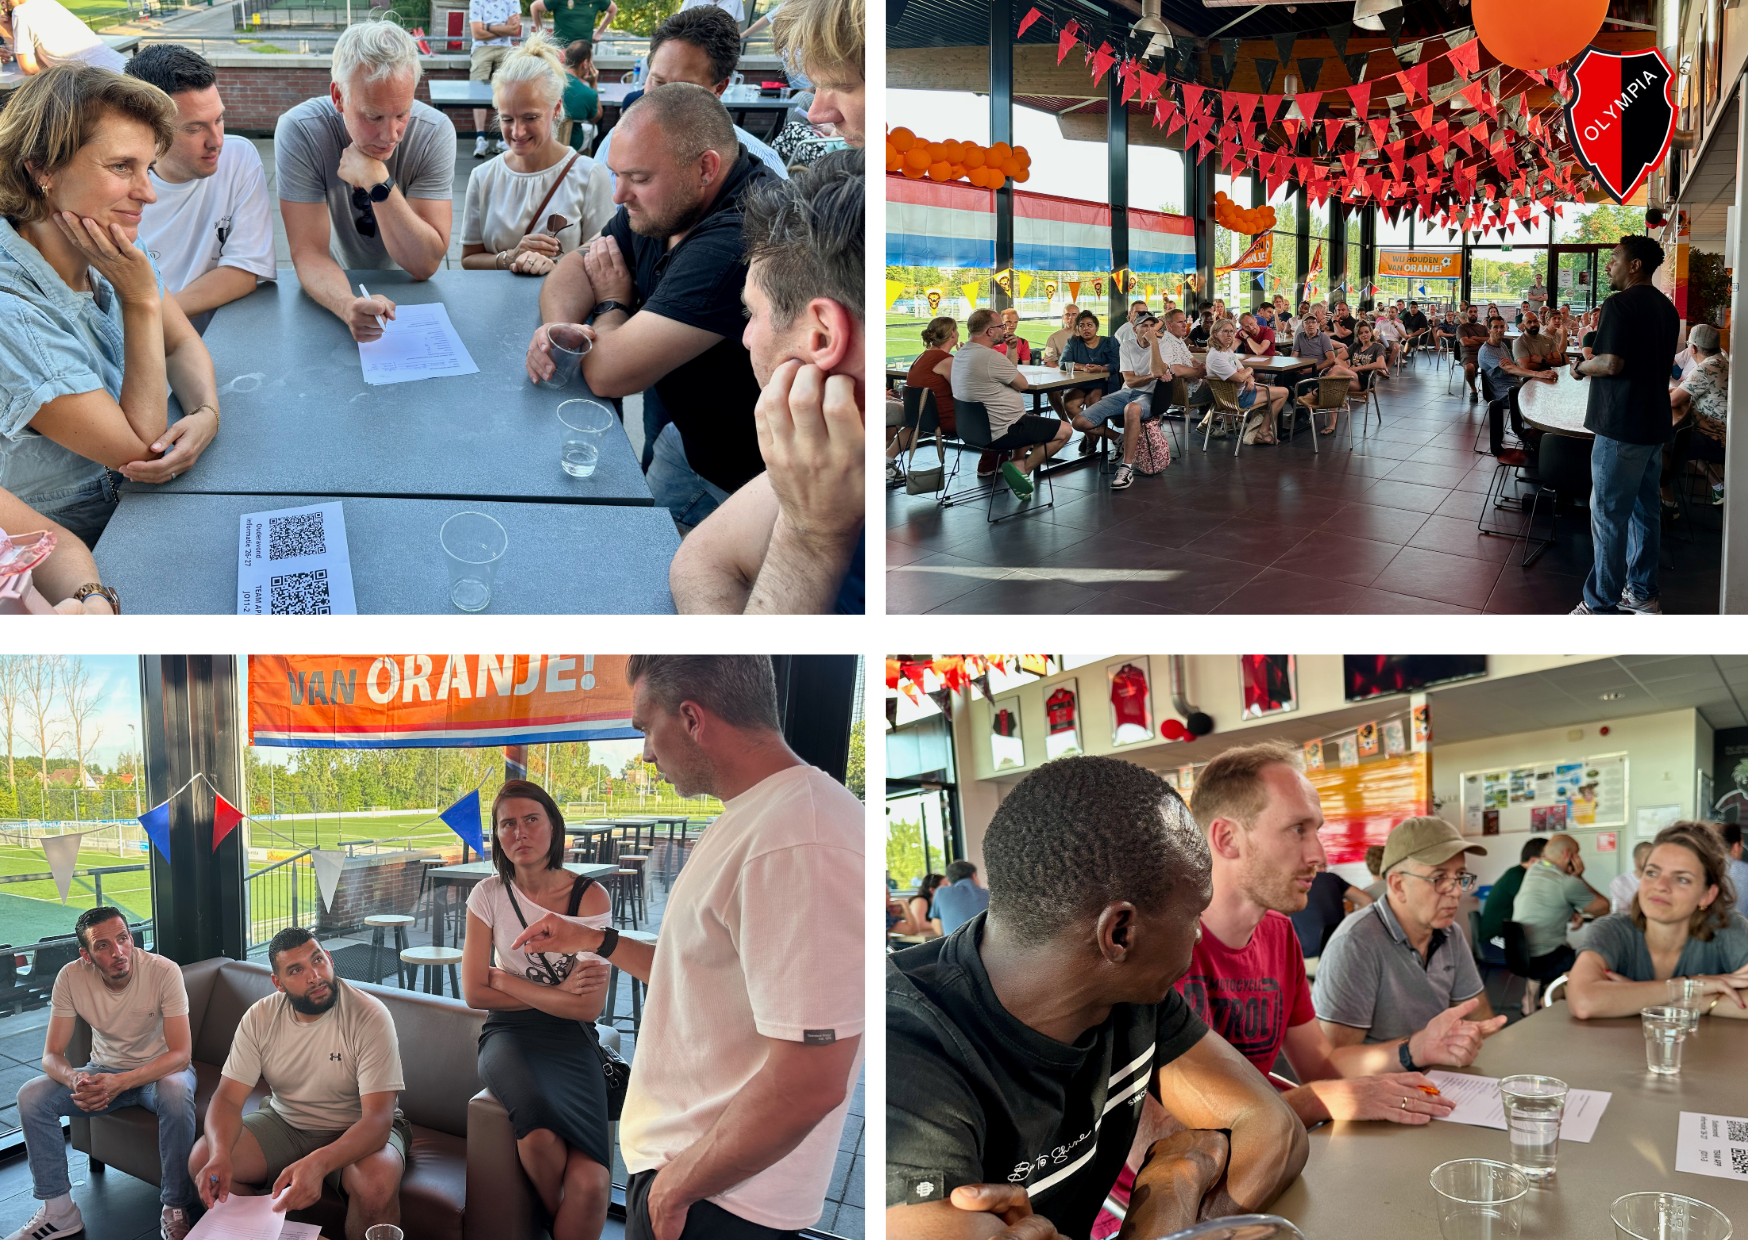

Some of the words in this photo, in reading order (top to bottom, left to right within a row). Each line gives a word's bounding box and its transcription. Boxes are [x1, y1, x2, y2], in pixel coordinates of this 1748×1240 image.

[1407, 256, 1439, 264] HOUDEN
[1404, 264, 1442, 273] ORANJE!
[287, 668, 357, 706] VAN
[366, 654, 597, 705] ORANJE!
